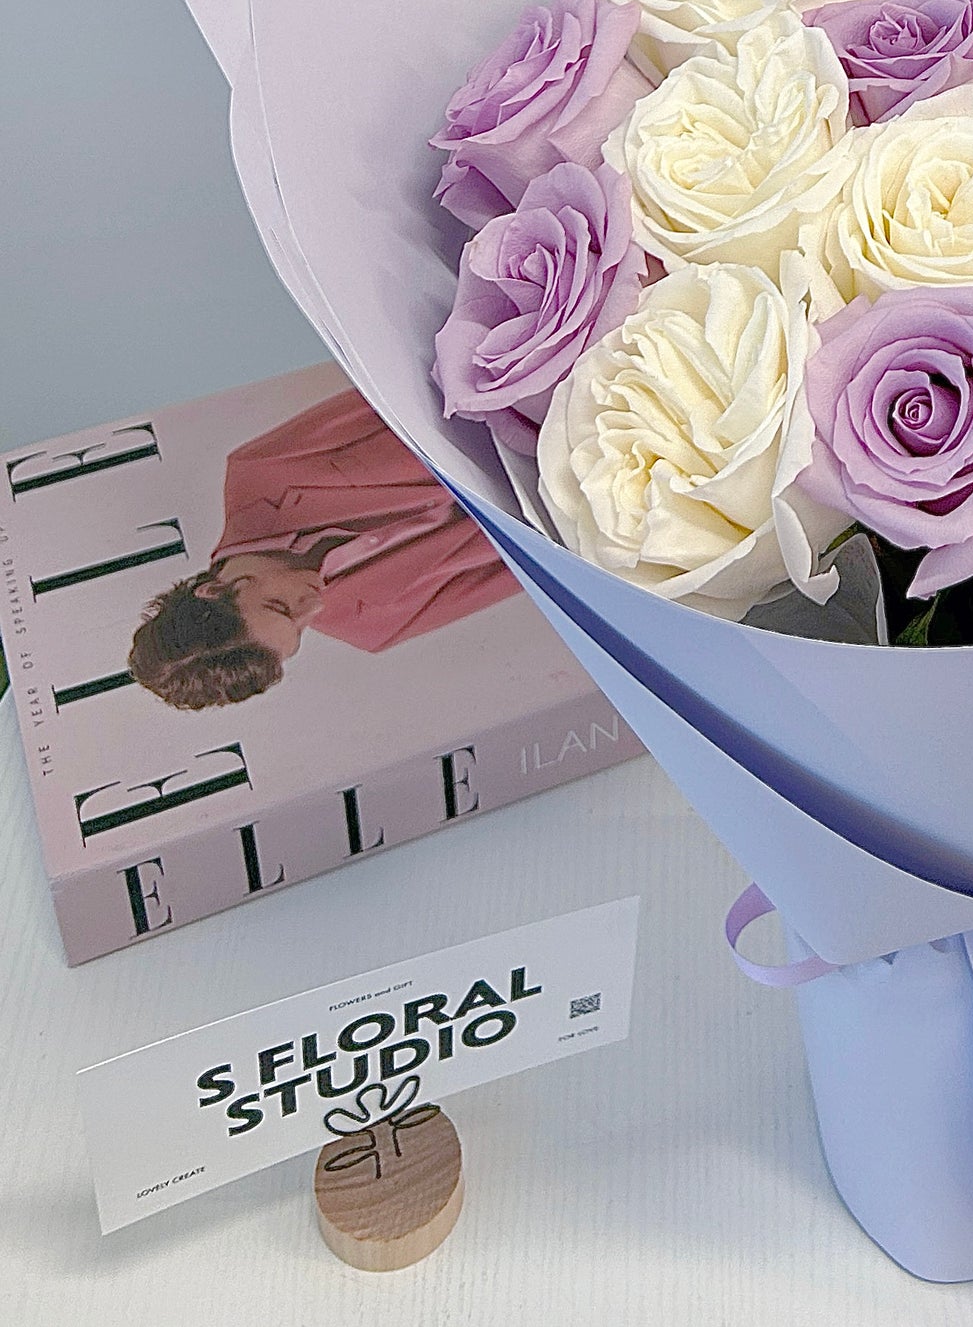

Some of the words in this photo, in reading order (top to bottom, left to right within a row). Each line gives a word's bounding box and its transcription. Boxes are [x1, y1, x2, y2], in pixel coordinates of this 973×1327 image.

[6, 421, 254, 849] ELE
[20, 652, 34, 670] OF
[27, 686, 45, 728] YEAR
[38, 745, 54, 777] THE
[115, 744, 481, 938] ELLE
[197, 1063, 235, 1108] S
[258, 966, 542, 1086] FLORAL
[226, 1010, 517, 1137] STUDIO
